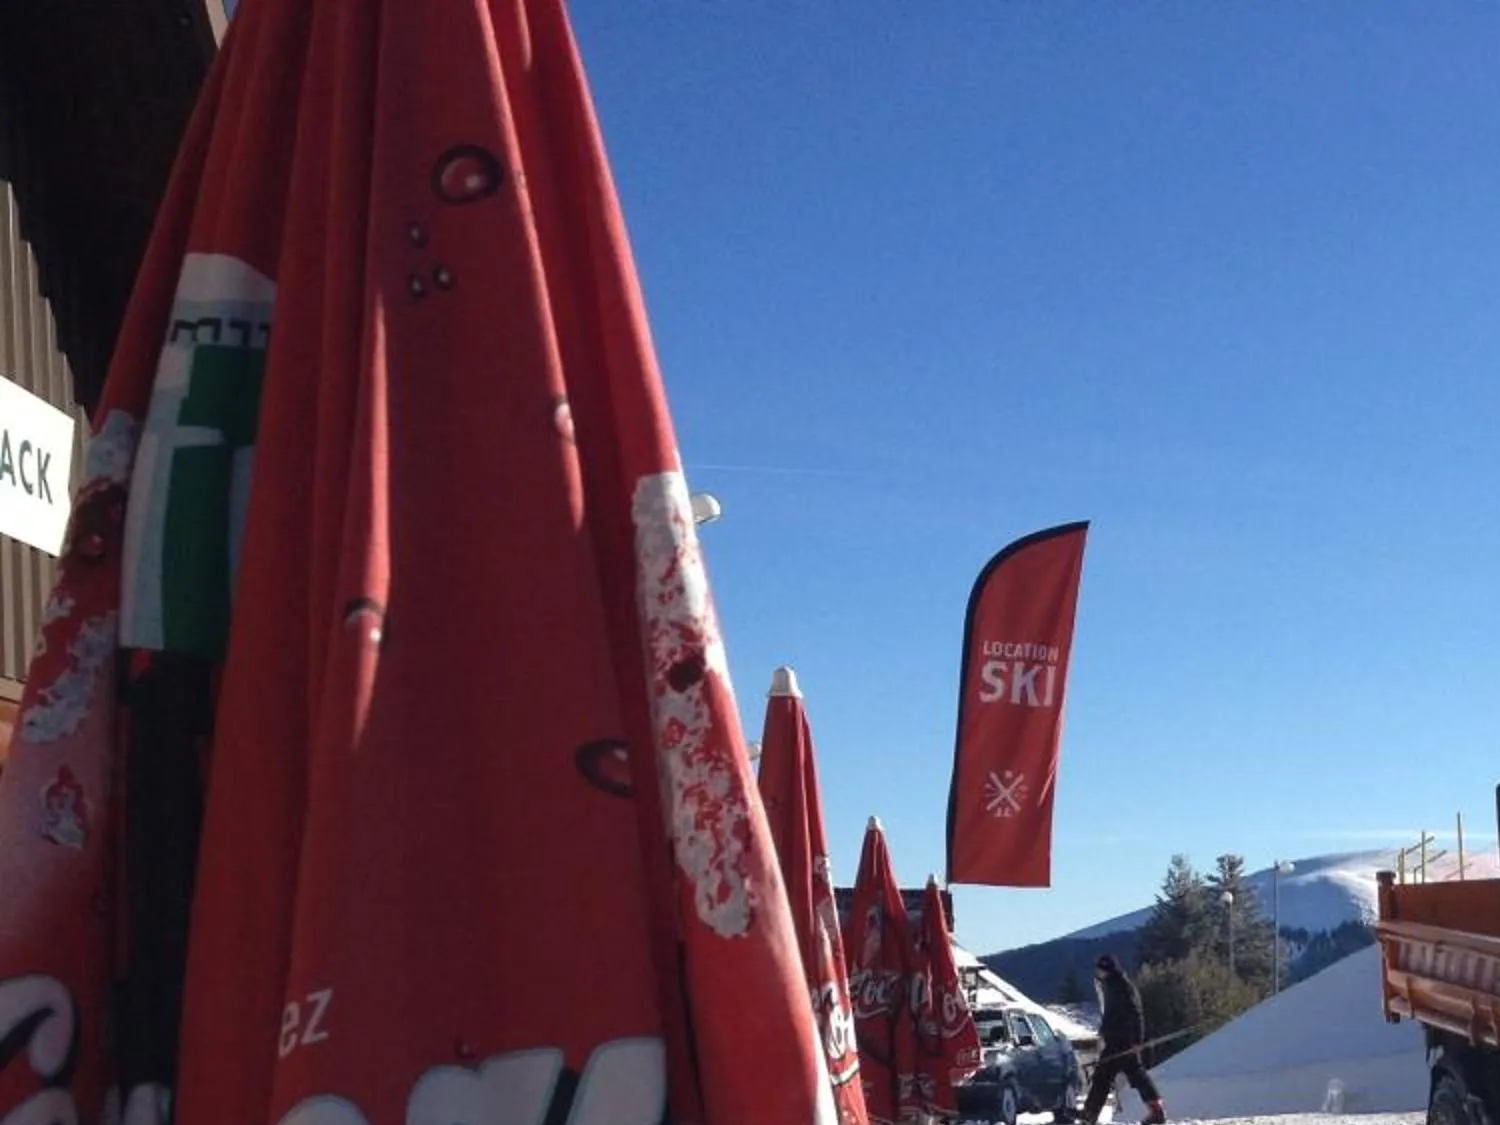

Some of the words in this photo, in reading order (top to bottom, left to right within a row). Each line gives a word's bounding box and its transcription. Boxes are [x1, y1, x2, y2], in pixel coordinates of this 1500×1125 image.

[0, 429, 53, 505] ACK
[983, 640, 1059, 661] LOCATION
[979, 660, 1058, 708] SKI
